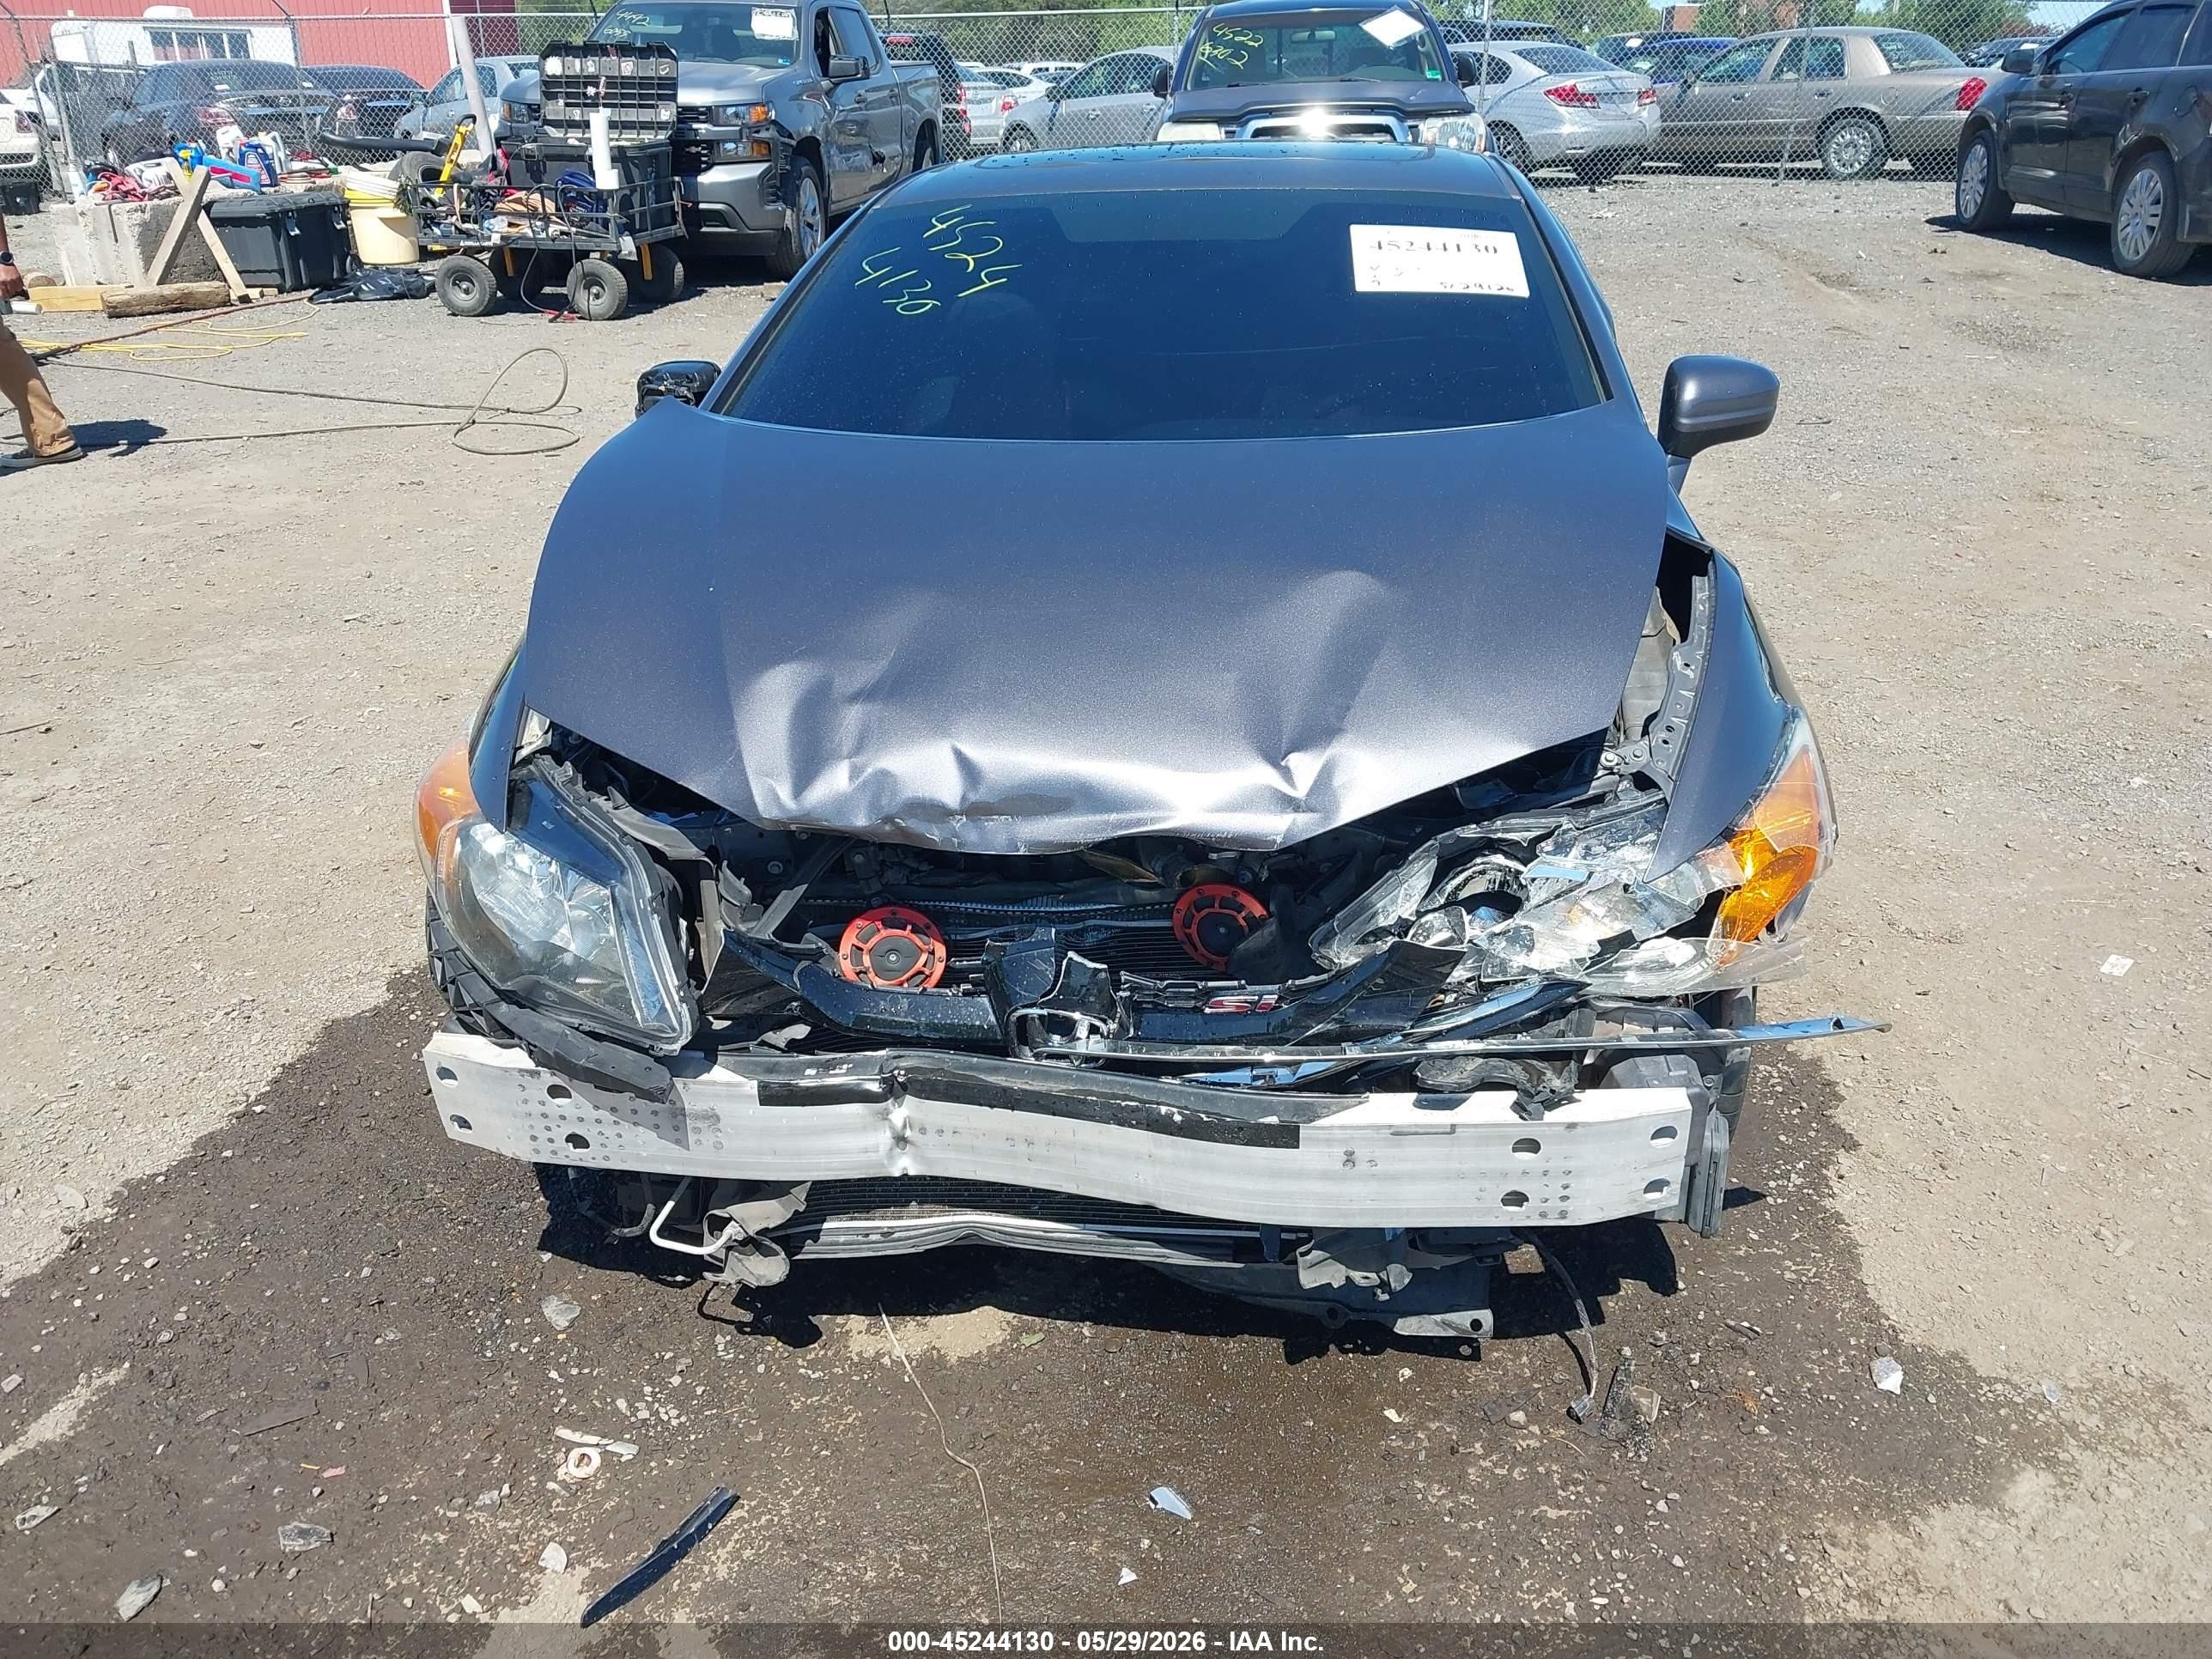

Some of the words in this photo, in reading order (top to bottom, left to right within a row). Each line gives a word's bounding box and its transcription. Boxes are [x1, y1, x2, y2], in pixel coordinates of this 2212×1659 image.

[1212, 23, 1263, 47] 4522
[923, 204, 1023, 297] 4524
[1369, 240, 1498, 255] 45244130
